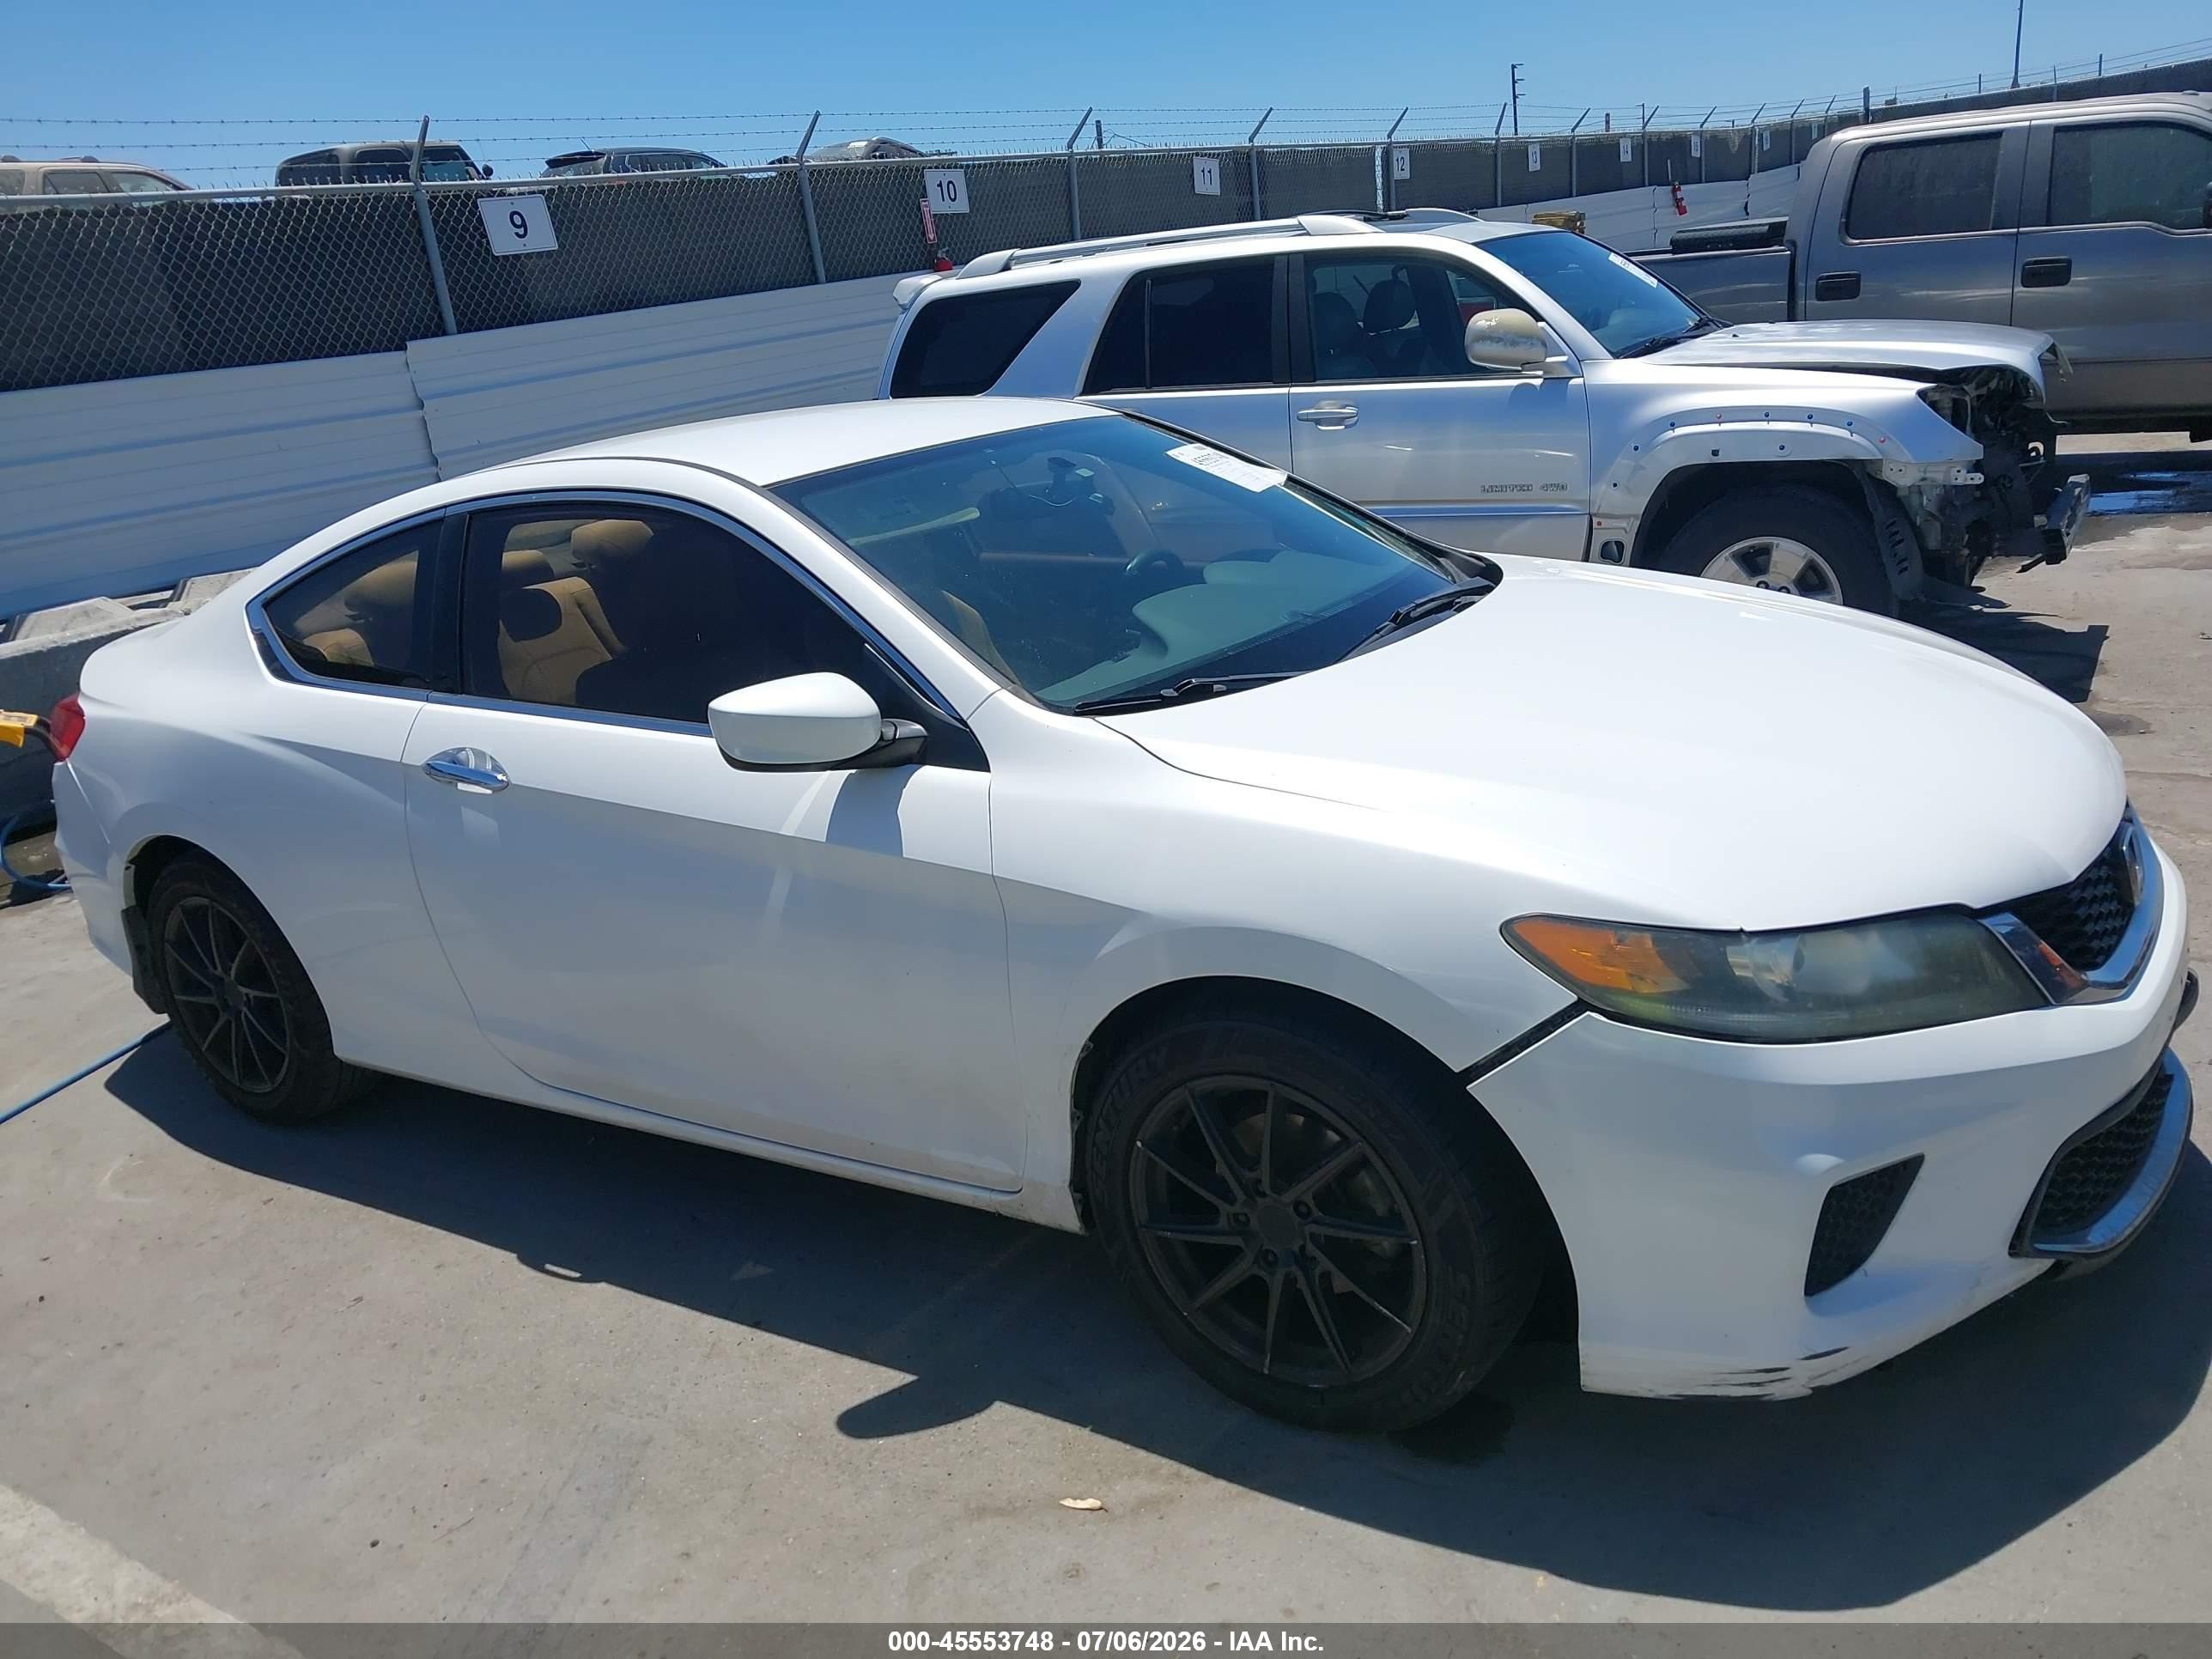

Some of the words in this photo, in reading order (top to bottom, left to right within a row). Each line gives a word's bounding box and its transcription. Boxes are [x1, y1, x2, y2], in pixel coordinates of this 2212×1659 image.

[1531, 150, 1538, 164] 13
[1622, 143, 1629, 155] 14
[1395, 156, 1405, 172] 12
[1200, 167, 1212, 186] 11
[936, 179, 957, 203] 10
[508, 210, 529, 240] 9
[1480, 483, 1534, 494] LIMITED
[1539, 482, 1568, 492] 4WD
